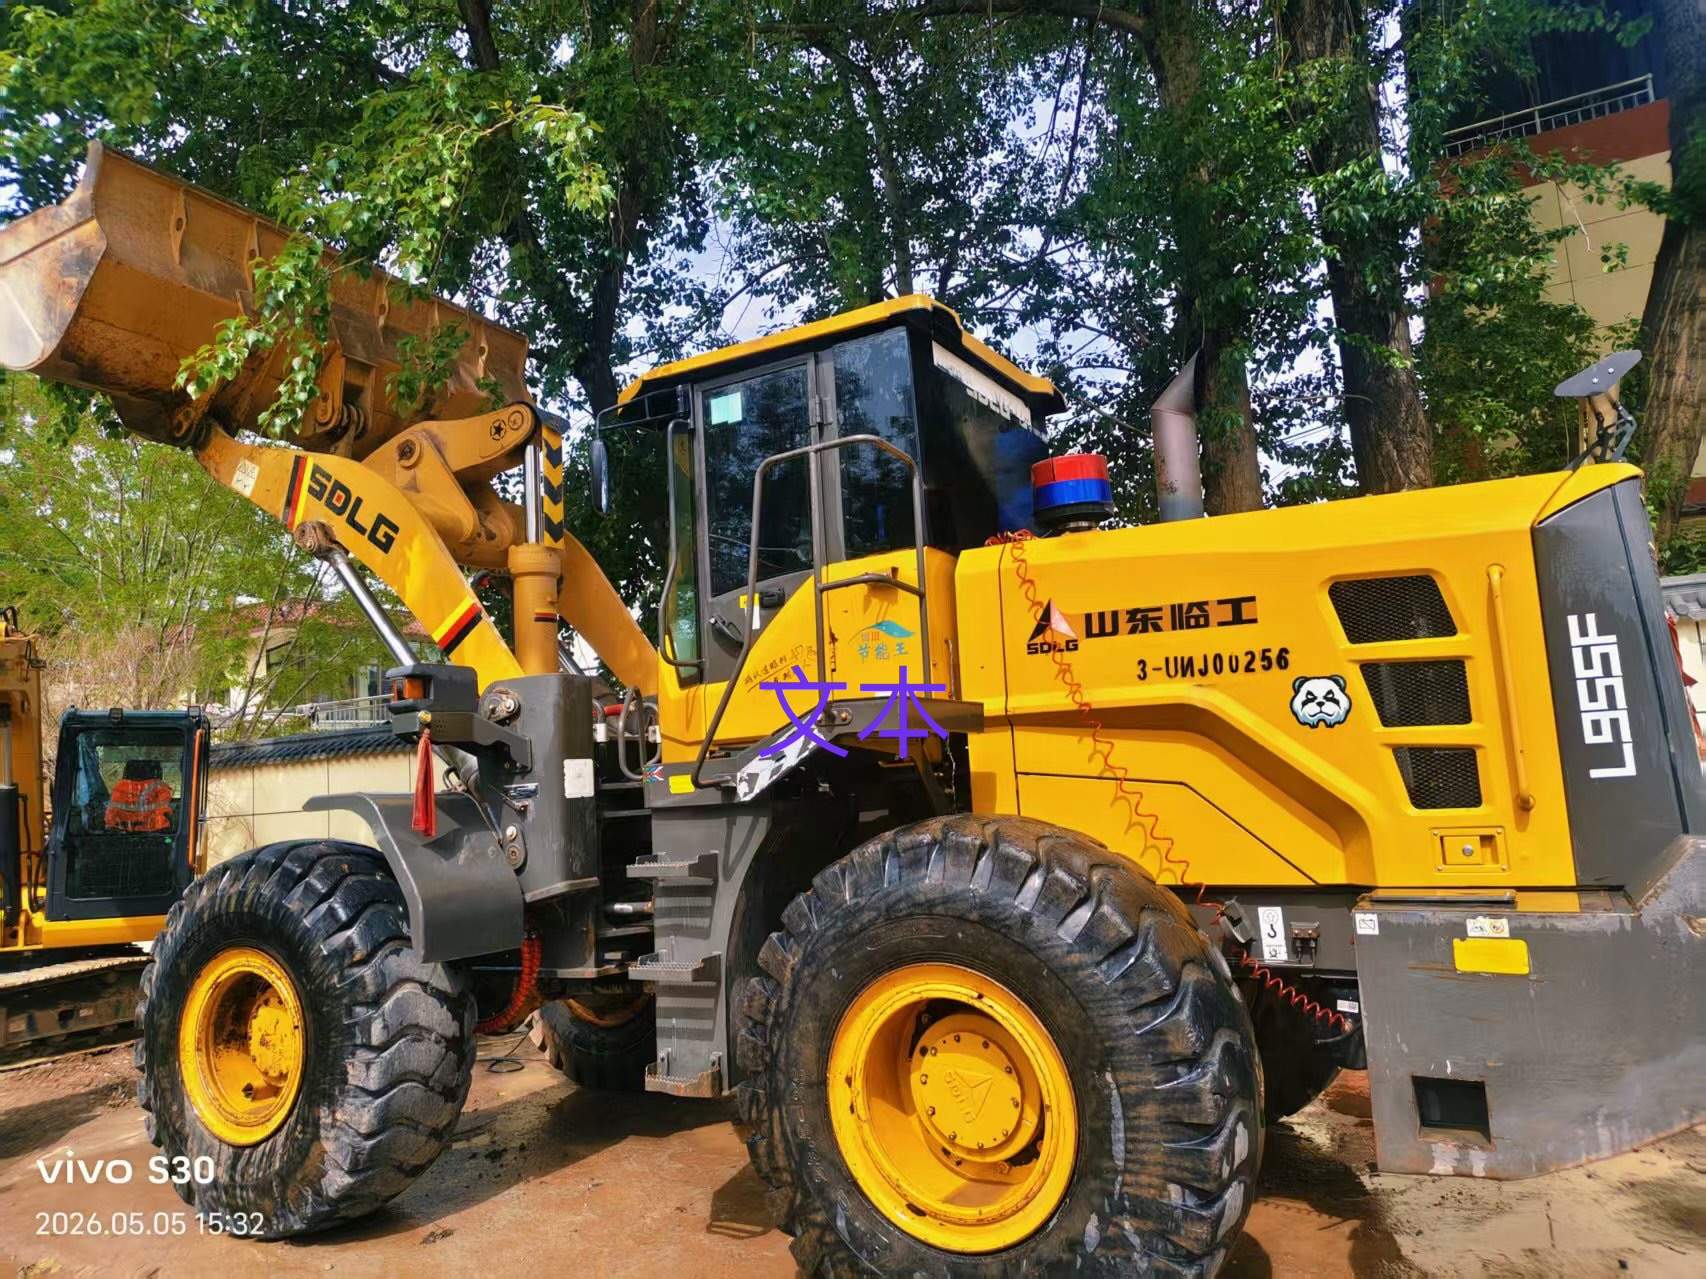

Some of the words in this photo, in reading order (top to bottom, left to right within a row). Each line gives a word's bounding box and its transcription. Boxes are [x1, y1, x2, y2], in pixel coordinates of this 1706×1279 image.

[307, 463, 400, 555] SDLG
[1026, 639, 1079, 655] SDLG
[1084, 595, 1258, 639] 山东临工
[1567, 613, 1637, 779] L955F
